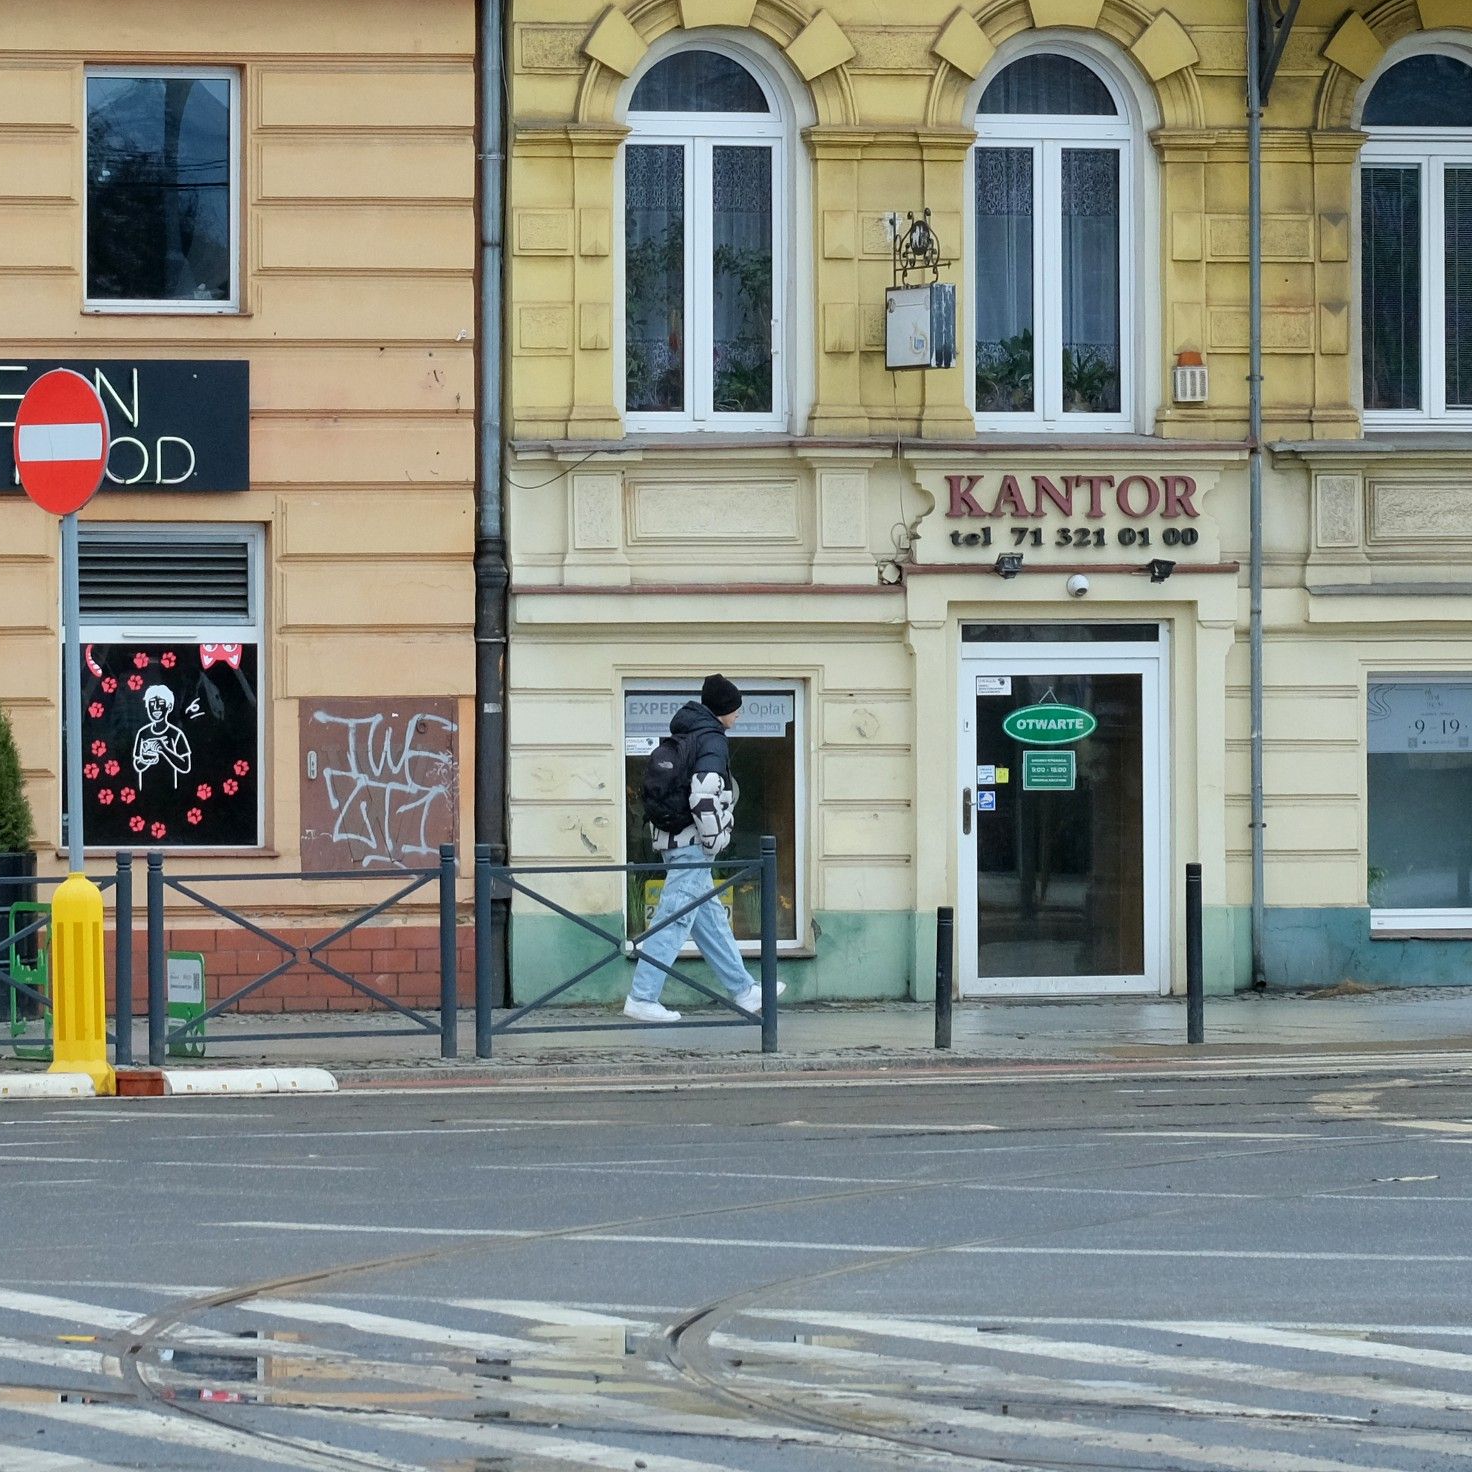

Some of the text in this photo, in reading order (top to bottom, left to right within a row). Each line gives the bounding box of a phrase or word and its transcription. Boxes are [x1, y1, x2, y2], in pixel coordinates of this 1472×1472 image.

[944, 475, 1201, 518] KANTOR
[950, 527, 1199, 546] tel 71 321 01 00
[749, 702, 785, 717] Opłat
[1016, 719, 1084, 730] OTWARTE
